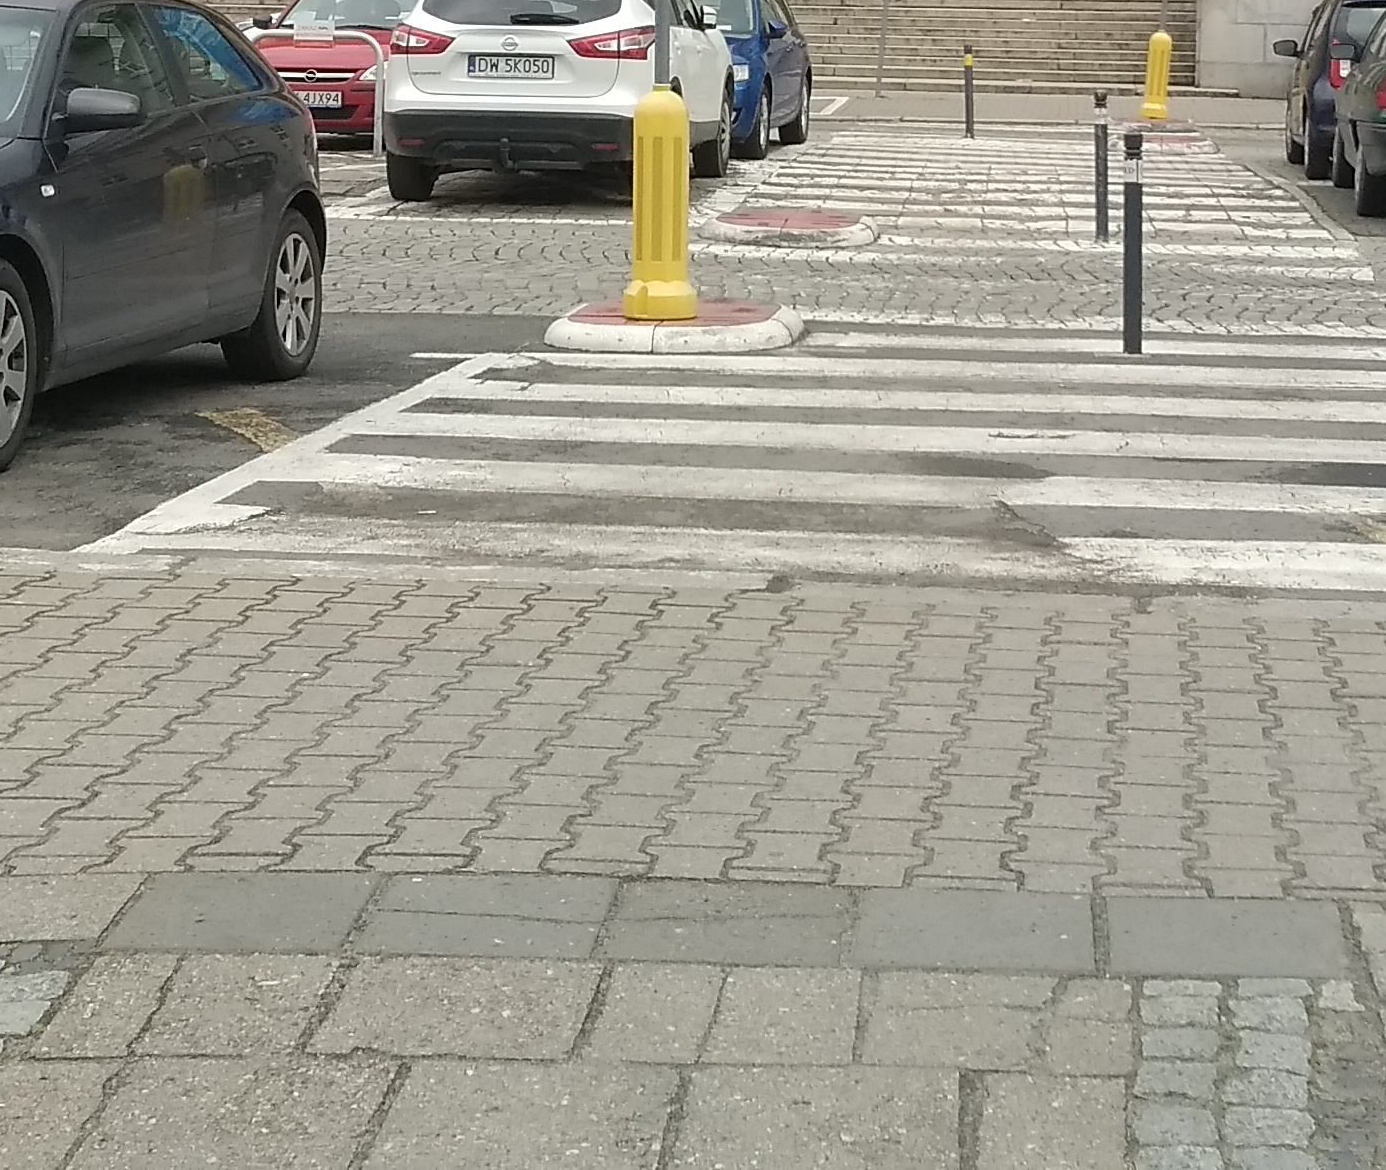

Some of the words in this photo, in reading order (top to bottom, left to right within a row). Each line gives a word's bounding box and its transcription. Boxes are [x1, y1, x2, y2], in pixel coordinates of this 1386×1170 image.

[477, 58, 500, 73] DW
[504, 58, 550, 74] 5K050
[303, 92, 339, 104] 4JX94
